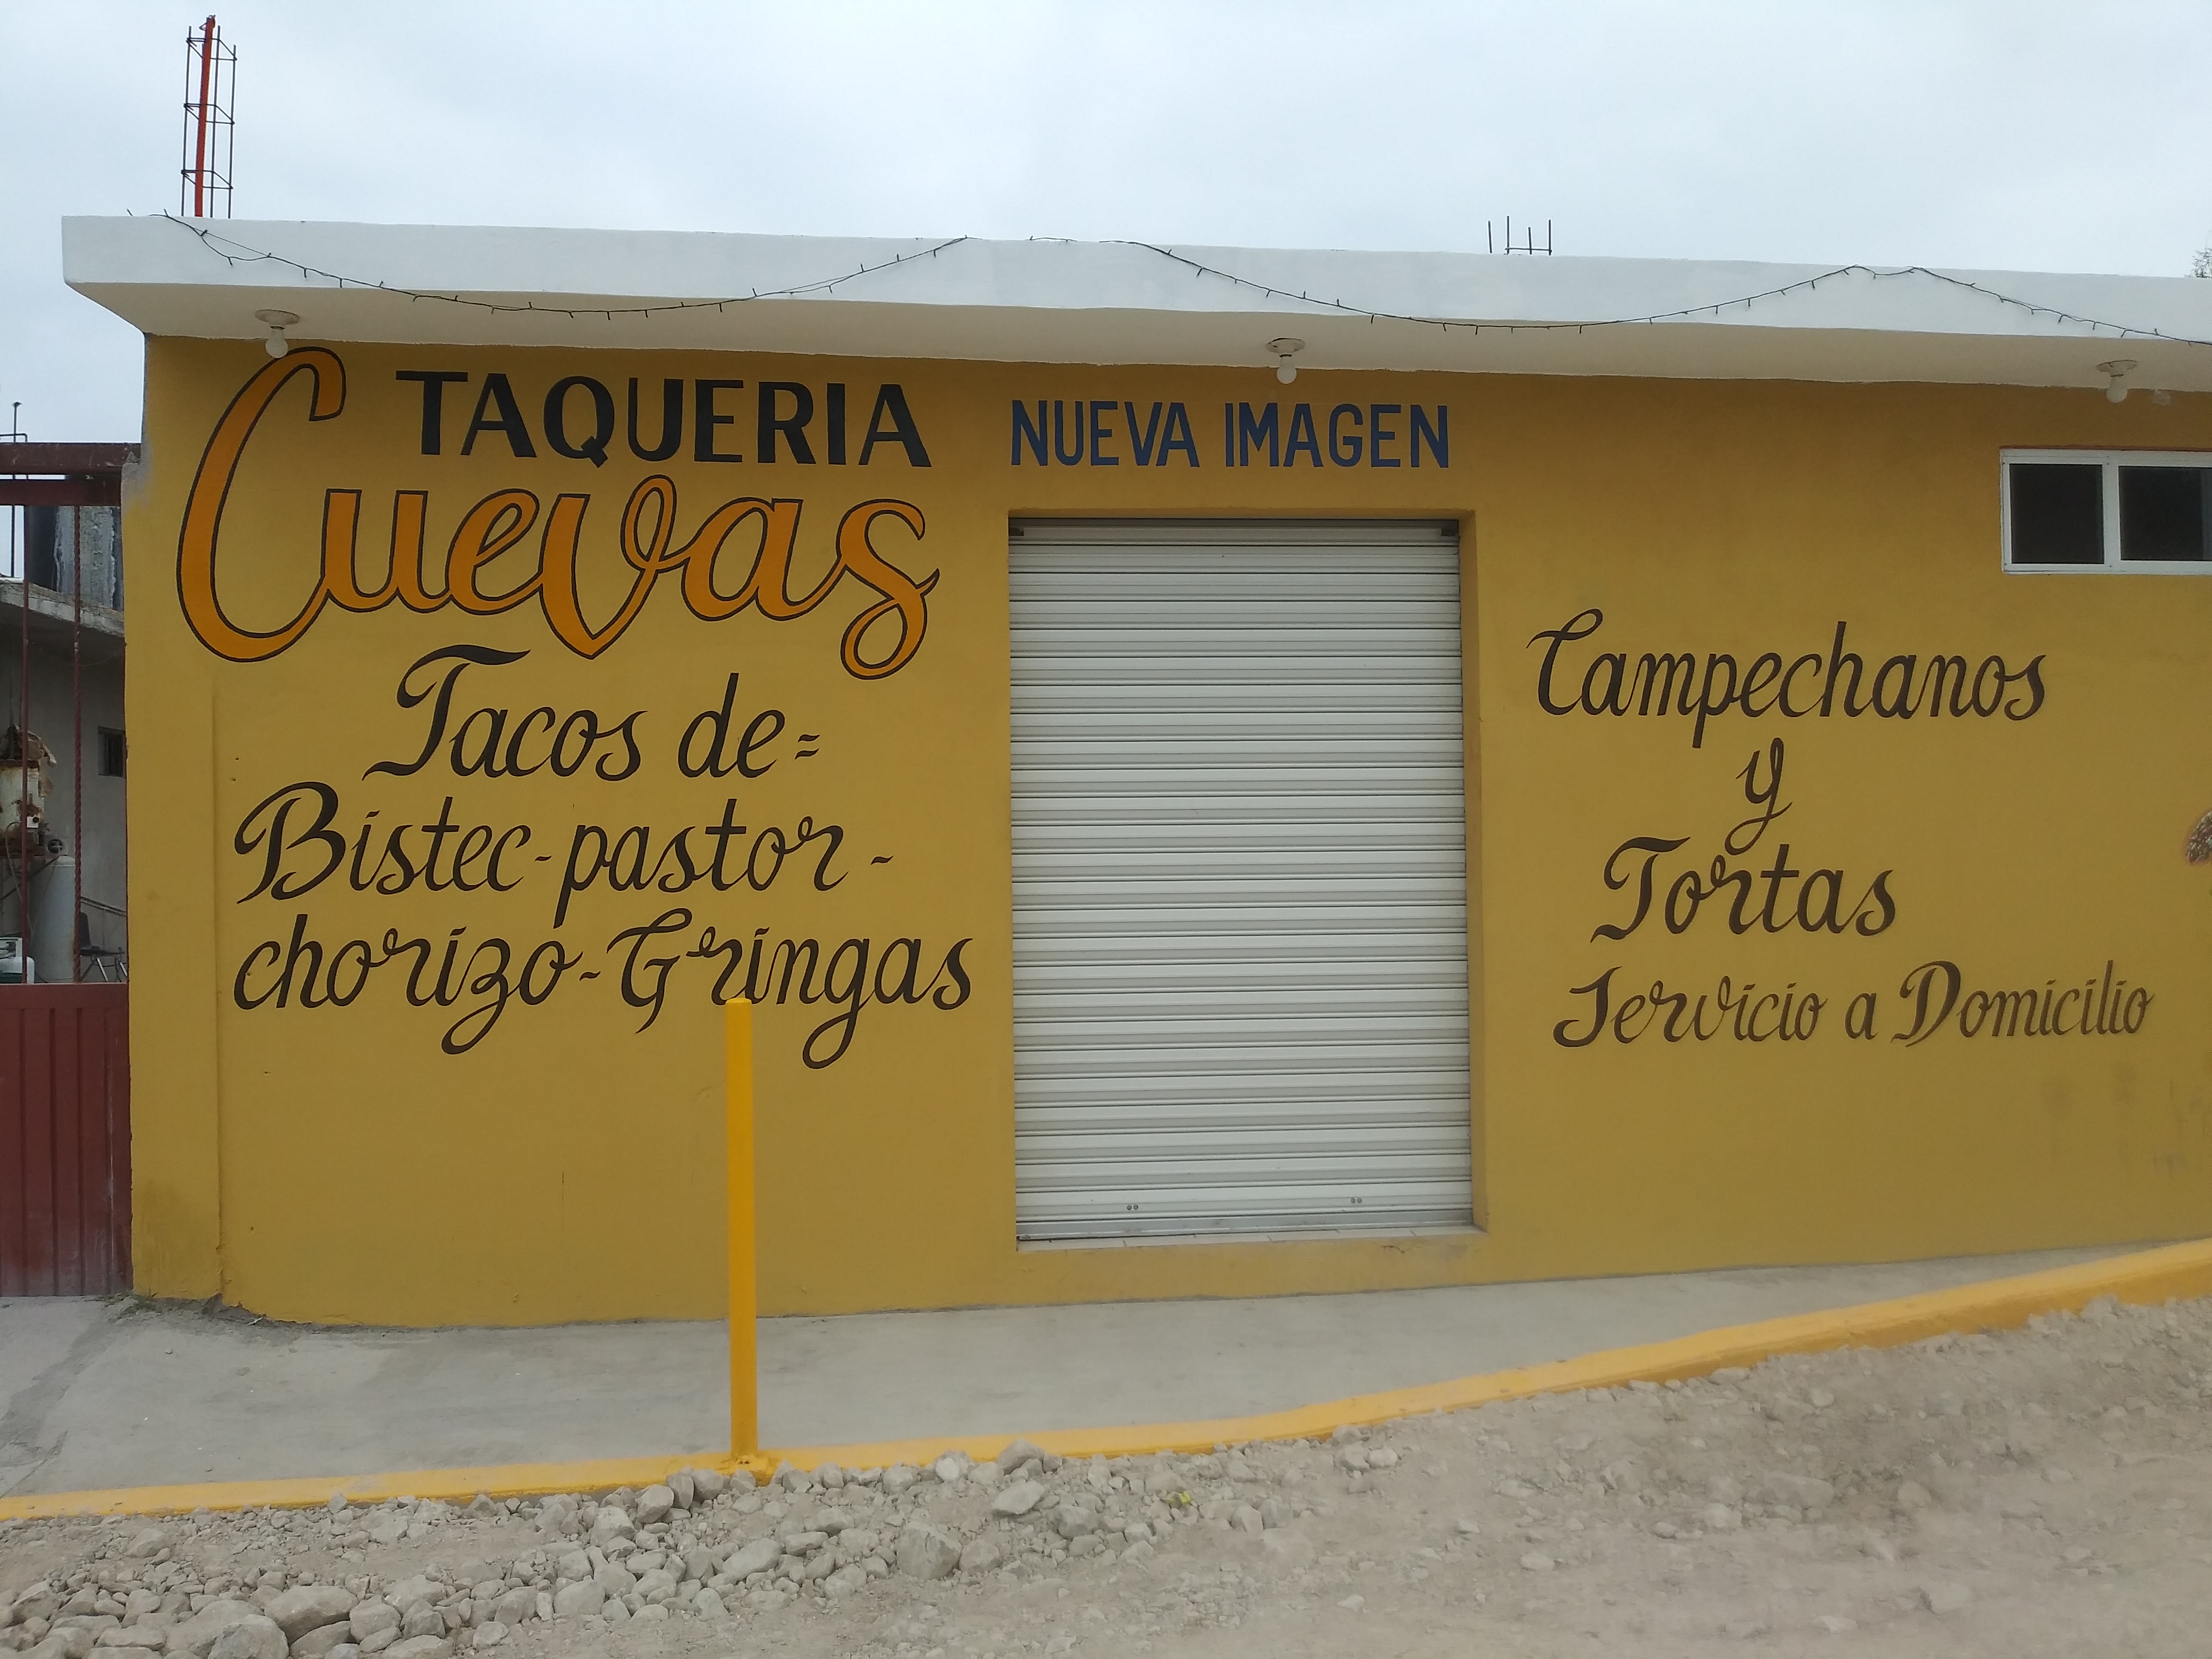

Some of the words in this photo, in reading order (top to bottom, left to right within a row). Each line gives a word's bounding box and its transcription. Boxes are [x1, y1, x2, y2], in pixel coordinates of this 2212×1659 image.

[396, 370, 932, 467] TAQUERIA
[1011, 400, 1200, 467] NUEVA
[1225, 403, 1449, 468] IMAGEN
[177, 346, 940, 680] Cuevas
[362, 644, 647, 782] Tacos
[1526, 609, 2047, 749] Campechanos
[1736, 738, 1793, 856] y
[1590, 836, 1896, 943] Tortas
[1553, 966, 1827, 1048] Servicio
[1844, 992, 1877, 1040] a
[1890, 959, 2155, 1047] Domicilio
